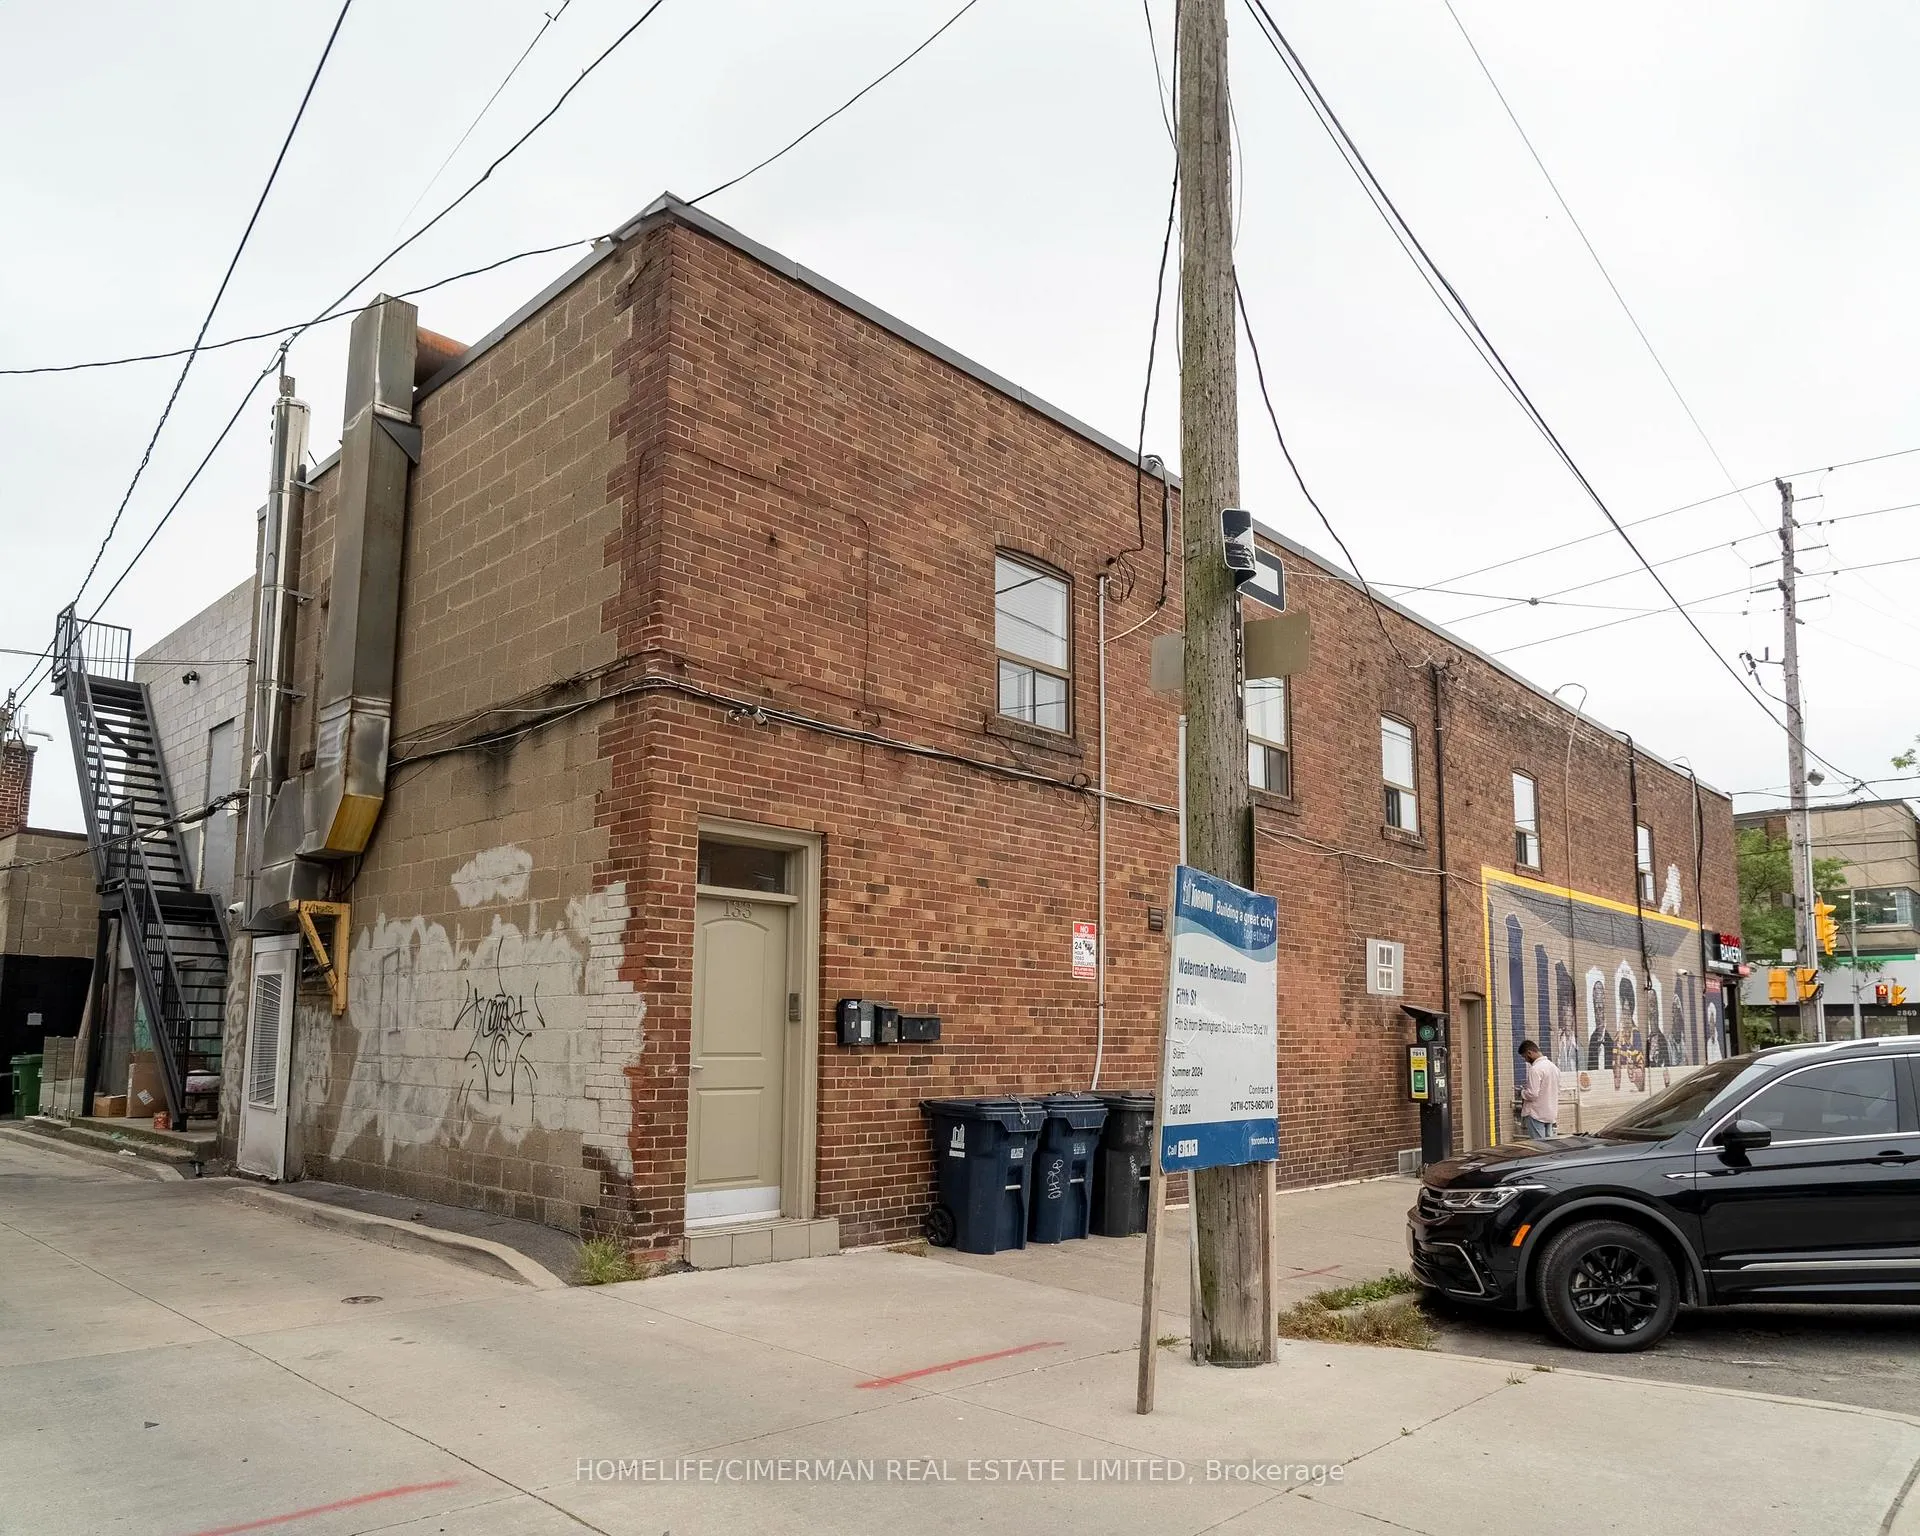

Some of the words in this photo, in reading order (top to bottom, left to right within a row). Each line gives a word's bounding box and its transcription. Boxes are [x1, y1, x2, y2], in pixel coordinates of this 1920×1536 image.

[1216, 900, 1239, 923] Building
[1239, 911, 1244, 922] a
[1244, 909, 1260, 925] great
[1261, 914, 1274, 931] city
[1244, 928, 1270, 943] together
[1074, 941, 1082, 950] 24
[1178, 957, 1209, 978] Watermain
[1210, 963, 1247, 984] Rehabilitation
[1176, 987, 1190, 1005] Fifth
[1190, 989, 1197, 1006] St
[1172, 1066, 1191, 1077] Summer
[1191, 1066, 1203, 1077] 2024
[1249, 1084, 1269, 1094] Contract
[1269, 1085, 1274, 1094] #
[1170, 1104, 1178, 1114] Fall
[1179, 1103, 1191, 1114] 2024
[1251, 1136, 1275, 1146] toronto.ca
[1167, 1145, 1177, 1156] Call
[1179, 1141, 1197, 1155] 311
